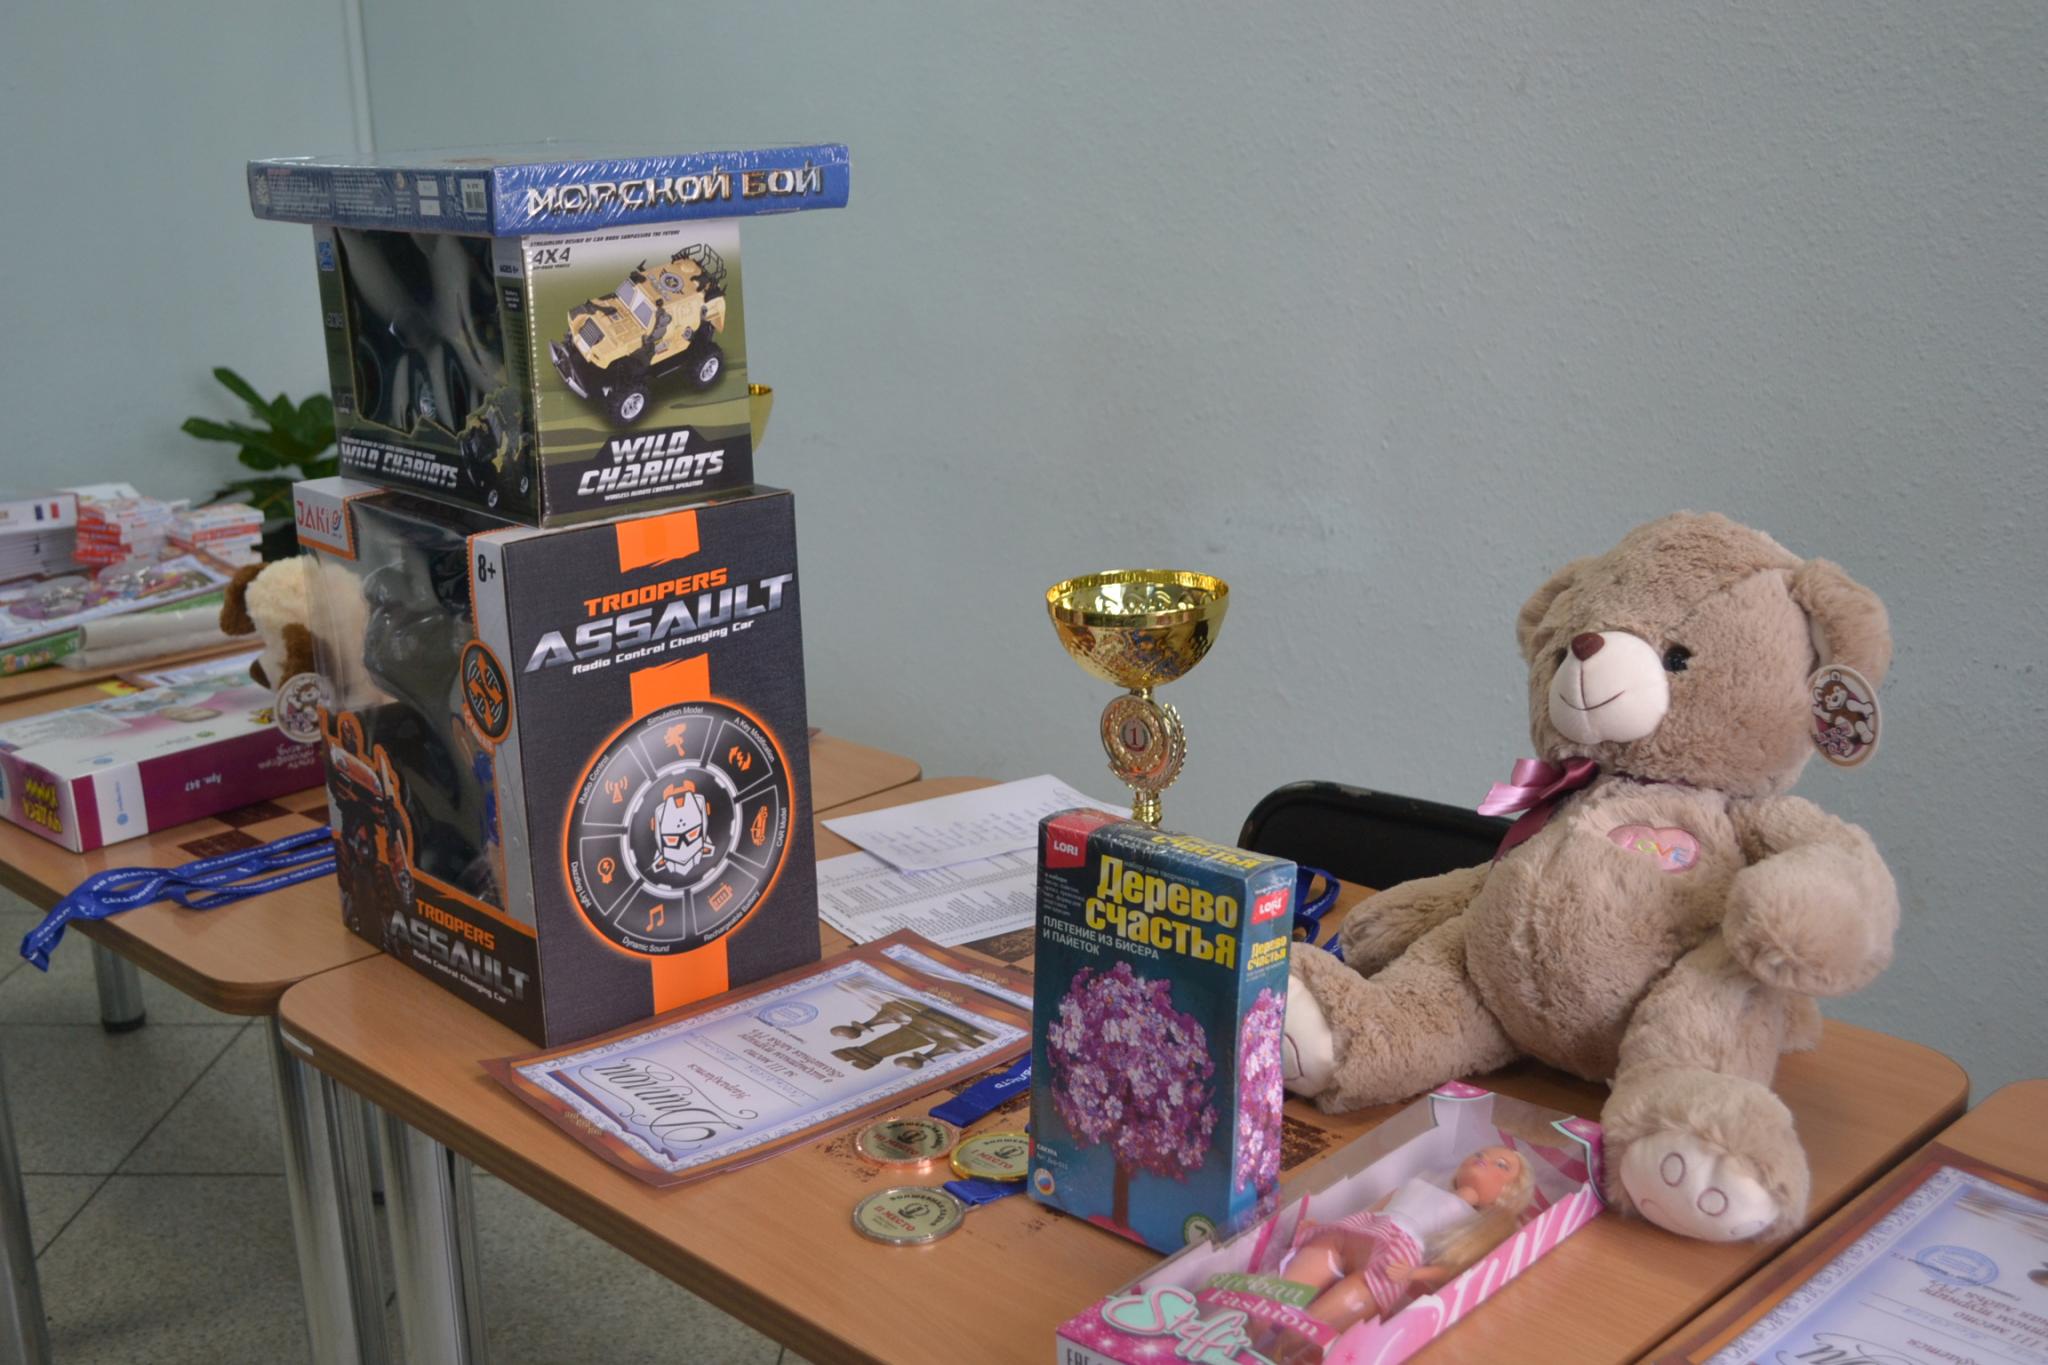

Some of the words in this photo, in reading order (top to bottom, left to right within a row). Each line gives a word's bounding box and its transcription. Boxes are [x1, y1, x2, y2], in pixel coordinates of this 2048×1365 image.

[527, 164, 732, 217] МОРСКОЙ
[742, 159, 822, 198] БОЙ
[532, 247, 571, 265] 4X4
[341, 443, 380, 470] WILD
[382, 451, 459, 489] CHARIOTS
[611, 430, 690, 465] WILD
[577, 450, 725, 496] CHARIOTS
[477, 553, 497, 583] 8+
[583, 567, 729, 617] TROOPERS
[524, 572, 794, 674] ASSAULT
[572, 656, 612, 675] Radio
[615, 641, 666, 665] Control
[669, 625, 729, 650] Changing
[732, 619, 755, 633] Car
[647, 707, 683, 726] Simulation
[683, 705, 704, 716] Model
[1053, 840, 1079, 857] LORI
[1097, 854, 1239, 930] Дерево
[416, 898, 496, 951] TROOPERS
[622, 936, 649, 952] Dynamic
[649, 944, 671, 953] Sound
[1043, 915, 1096, 941] ПЛЕТЕНИЕ
[1098, 932, 1113, 947] ИЗ
[1115, 938, 1160, 961] БИСЕРА
[1043, 928, 1051, 939] И
[1052, 930, 1100, 956] ПАЙЕТОК
[1085, 897, 1238, 971] счастья
[386, 910, 531, 1001] ASSAULT
[433, 959, 459, 979] Control
[460, 974, 493, 999] Changing
[979, 1151, 1014, 1170] МЕСТО
[882, 1207, 916, 1232] МЕСТО
[1209, 1288, 1320, 1338] Fashion
